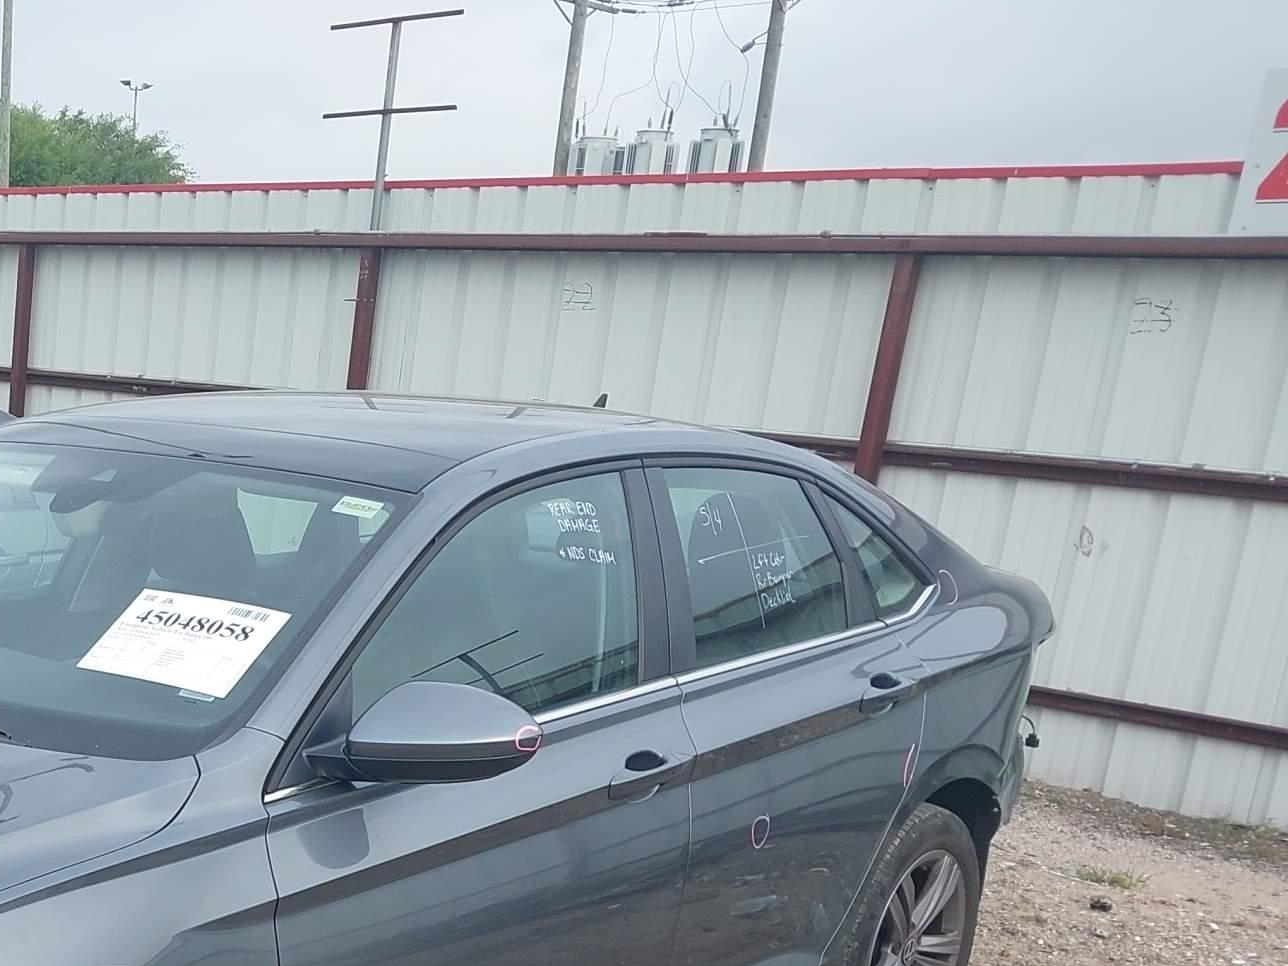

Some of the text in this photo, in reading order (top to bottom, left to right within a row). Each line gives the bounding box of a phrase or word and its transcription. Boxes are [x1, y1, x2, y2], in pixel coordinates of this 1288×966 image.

[547, 501, 597, 517] REAR END
[557, 518, 601, 533] DAMAGE
[588, 548, 617, 566] CLAIM
[135, 608, 255, 643] 45048058
